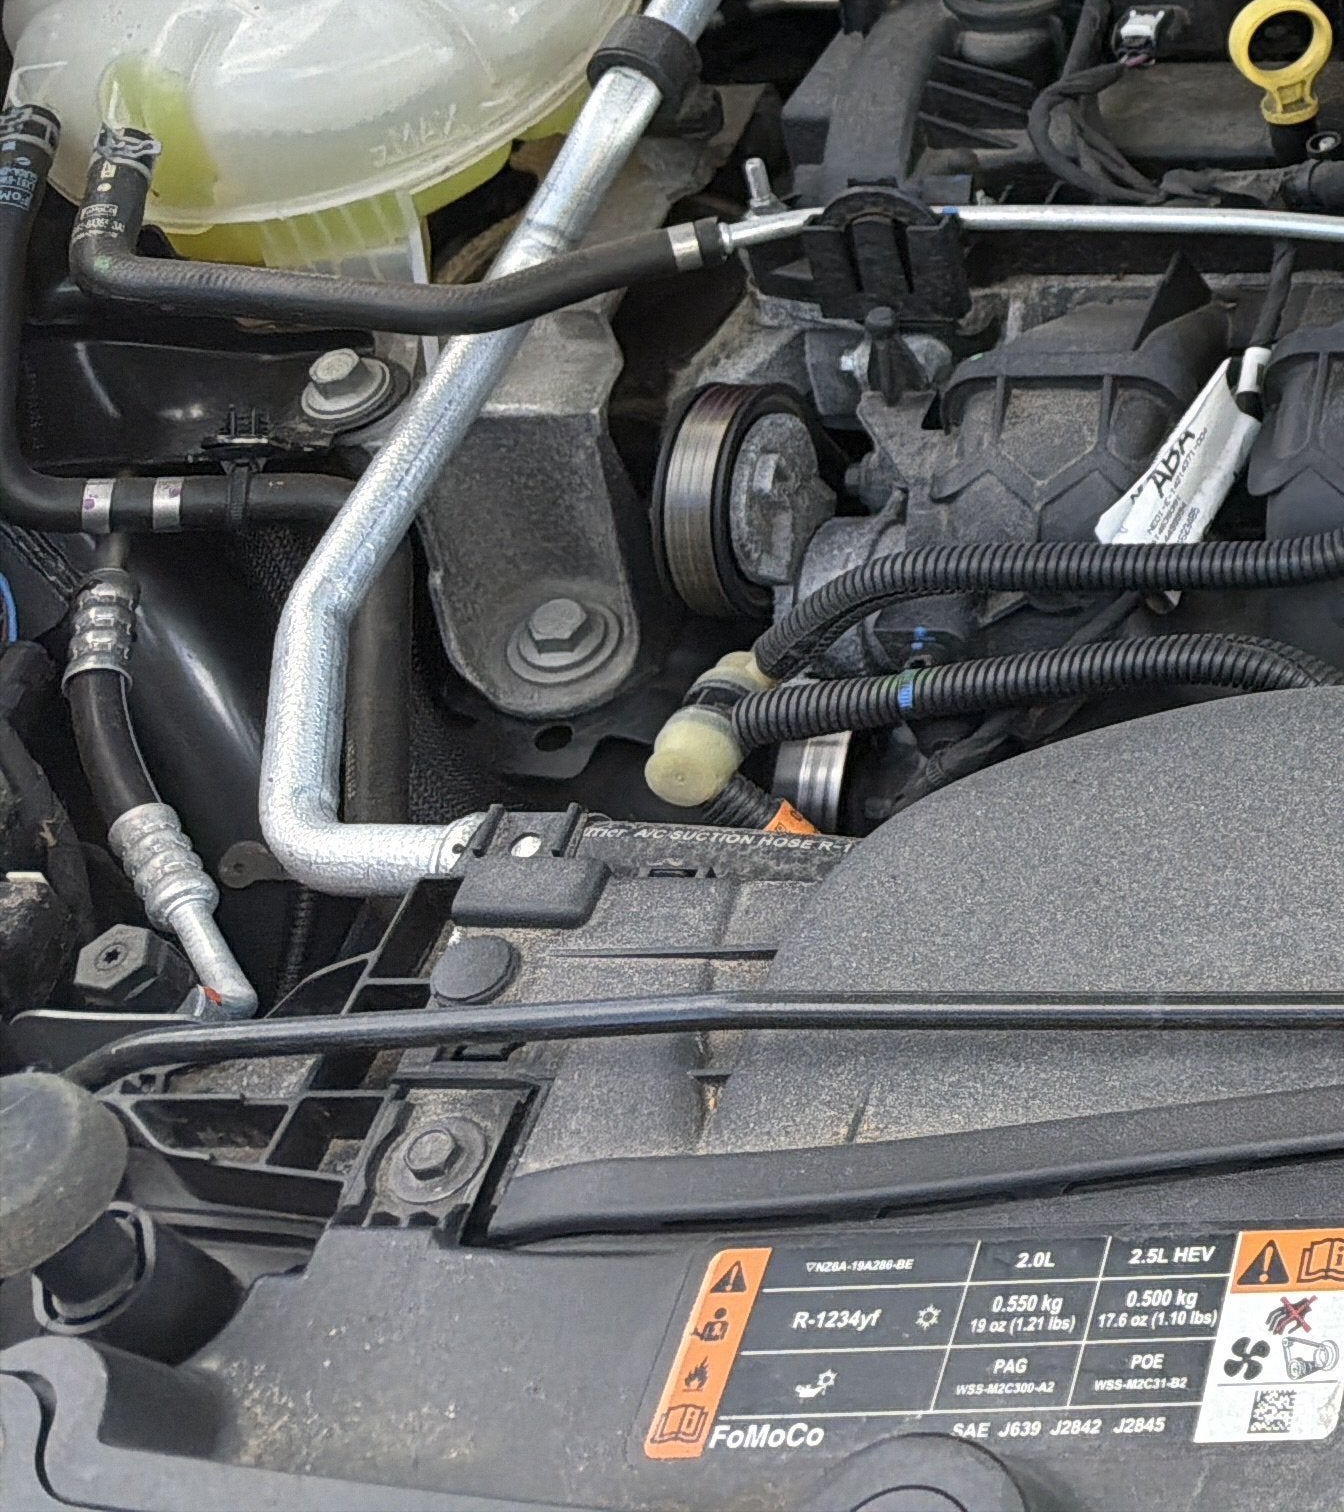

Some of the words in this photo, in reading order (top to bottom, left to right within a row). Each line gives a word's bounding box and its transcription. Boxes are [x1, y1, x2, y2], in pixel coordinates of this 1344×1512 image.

[670, 829, 759, 845] SUCTION
[758, 835, 815, 850] HOSE
[1015, 1252, 1056, 1269] 2.0L
[1128, 1248, 1169, 1265] 2.5L
[1173, 1246, 1216, 1263] HEV
[992, 1295, 1037, 1313] 0.550
[1041, 1294, 1063, 1315] kg
[1126, 1290, 1172, 1308] 0.500
[1175, 1289, 1198, 1309] kg
[792, 1309, 882, 1332] R-1234yf
[971, 1319, 986, 1333] 19
[989, 1320, 1006, 1333] oz
[1009, 1317, 1044, 1335] (1.21
[1048, 1315, 1076, 1334] lbs)
[1099, 1313, 1127, 1328] 17.6
[1131, 1315, 1148, 1328] oz
[1151, 1311, 1186, 1330] (1.10
[1189, 1310, 1218, 1329] lbs)
[993, 1358, 1028, 1374] PAG
[1130, 1354, 1165, 1370] POE
[708, 1422, 825, 1449] FoMoCo
[953, 1422, 991, 1438] SAE
[998, 1421, 1042, 1437] J639
[1050, 1419, 1102, 1436] J2842
[1113, 1417, 1166, 1434] J2845
